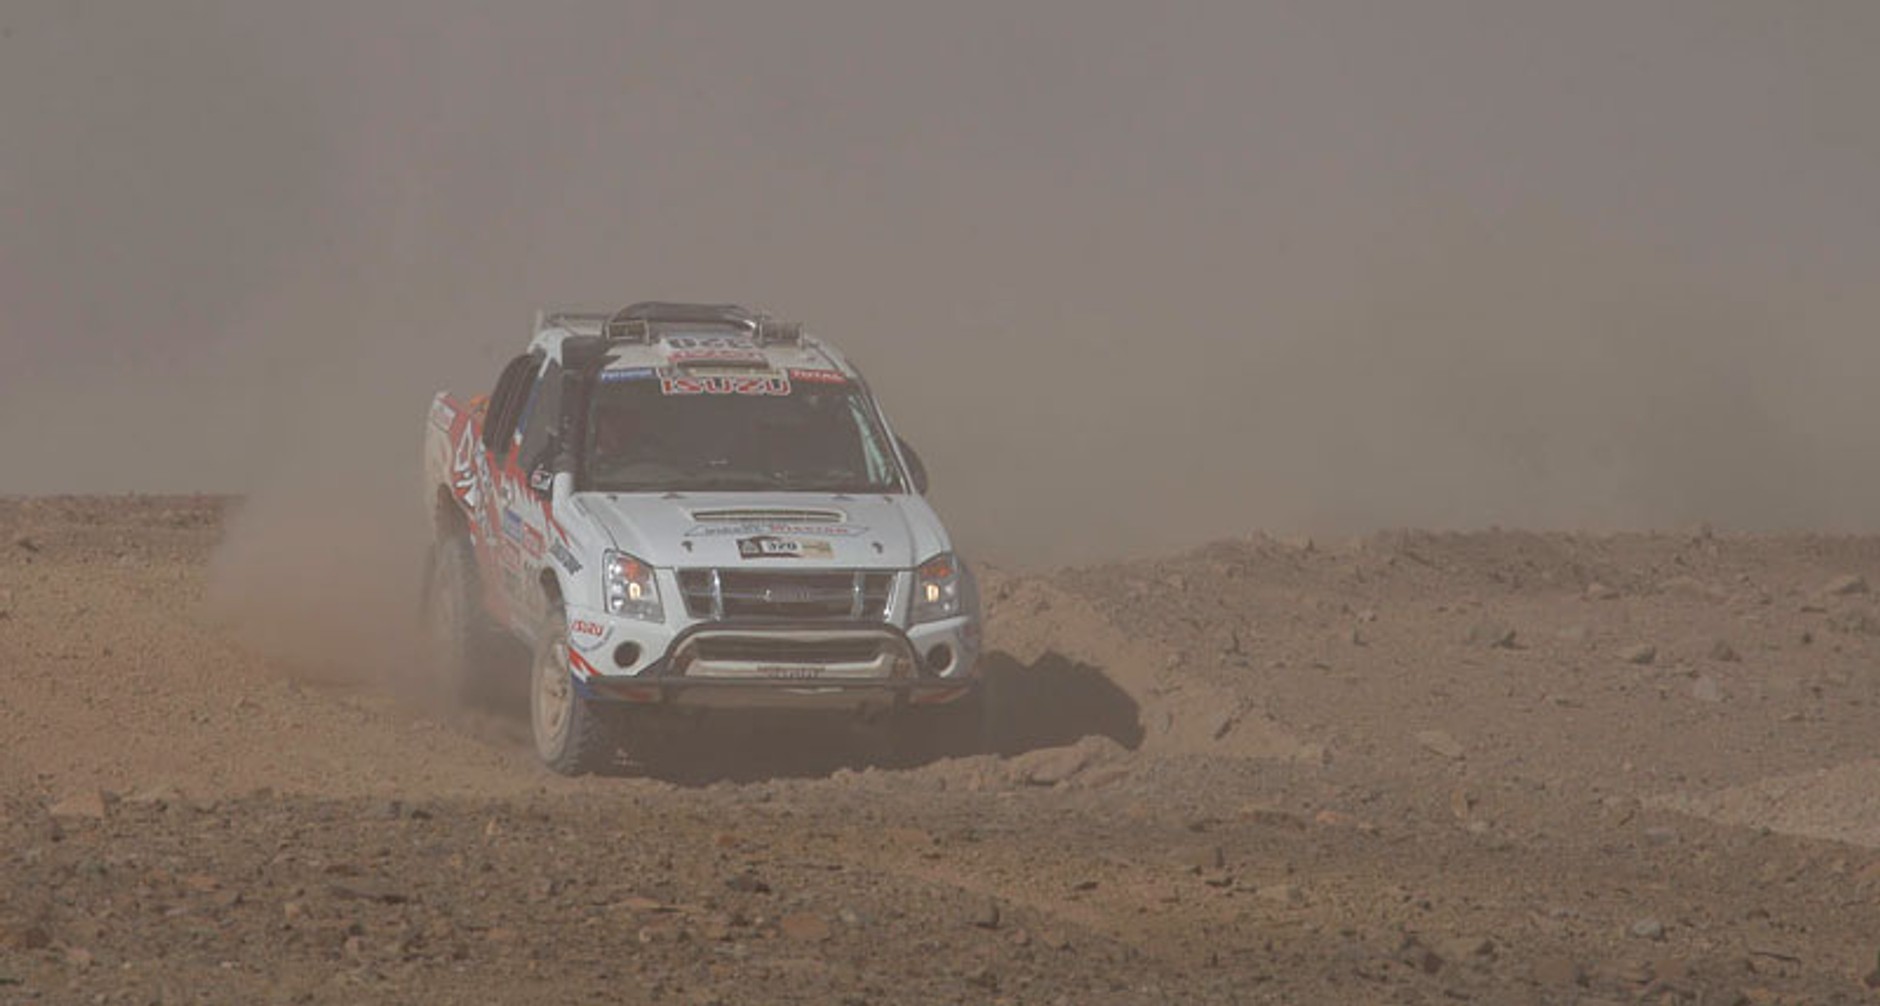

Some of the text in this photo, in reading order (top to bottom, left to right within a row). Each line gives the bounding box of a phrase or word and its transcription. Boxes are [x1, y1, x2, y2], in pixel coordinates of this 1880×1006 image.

[662, 376, 791, 395] ISUZU
[767, 541, 798, 551] 320
[571, 619, 603, 637] ISUZU
